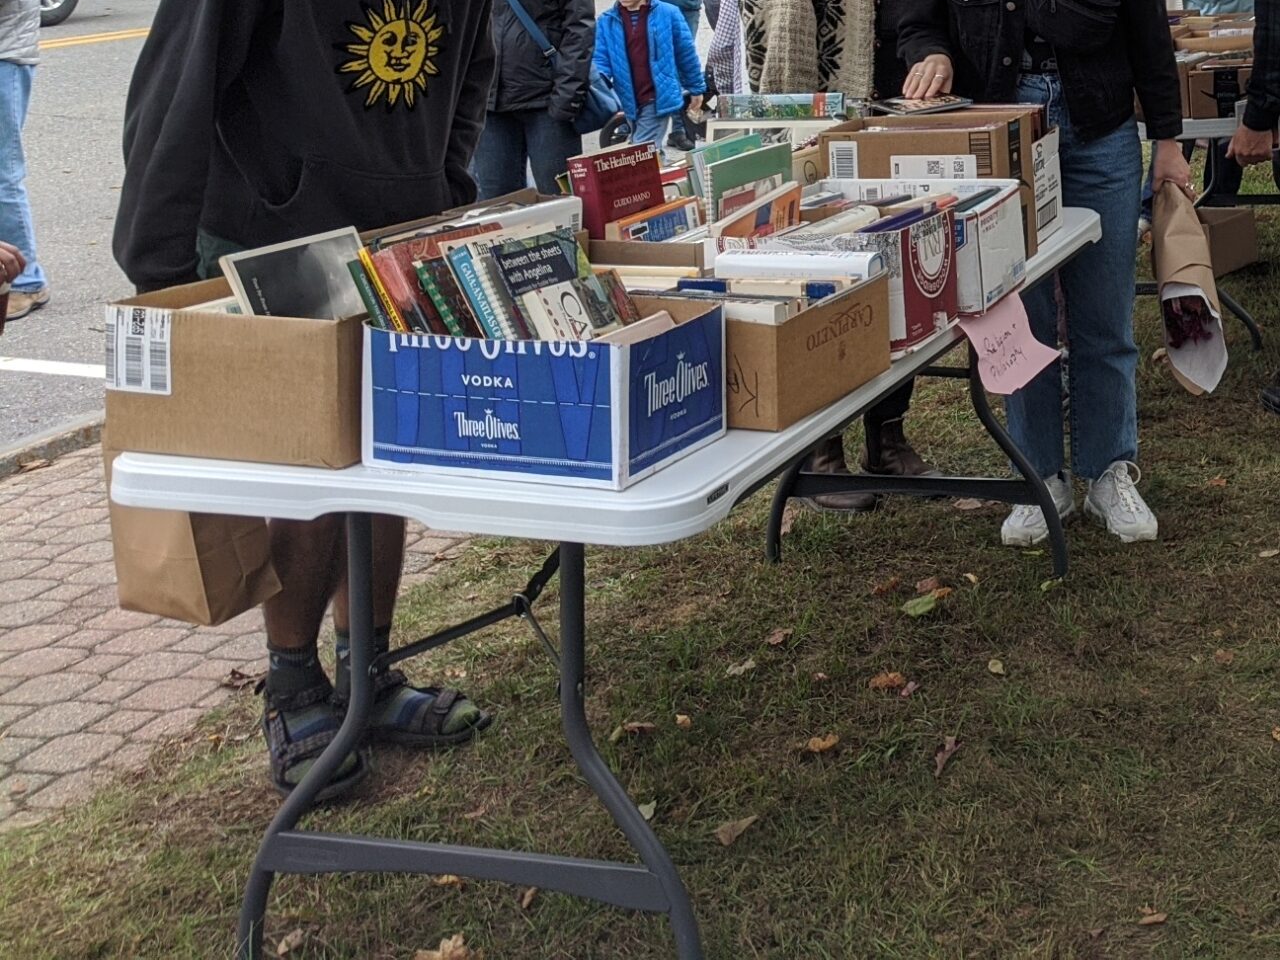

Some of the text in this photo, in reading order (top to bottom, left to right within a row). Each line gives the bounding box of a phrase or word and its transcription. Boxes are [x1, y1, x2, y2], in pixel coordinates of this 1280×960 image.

[594, 150, 654, 172] The Healing Hand
[614, 197, 632, 208] GUIDO
[501, 245, 562, 270] between the sheets
[508, 264, 554, 284] with Angelina
[459, 262, 479, 289] GAIA:
[476, 297, 498, 328] ATLAS
[381, 292, 402, 329] SCROLL SAW
[806, 304, 873, 352] CARPINETO
[461, 374, 514, 389] VODKA
[645, 360, 708, 418] Three Olives
[454, 411, 520, 440] Three Olives
[669, 408, 688, 420] VODKA
